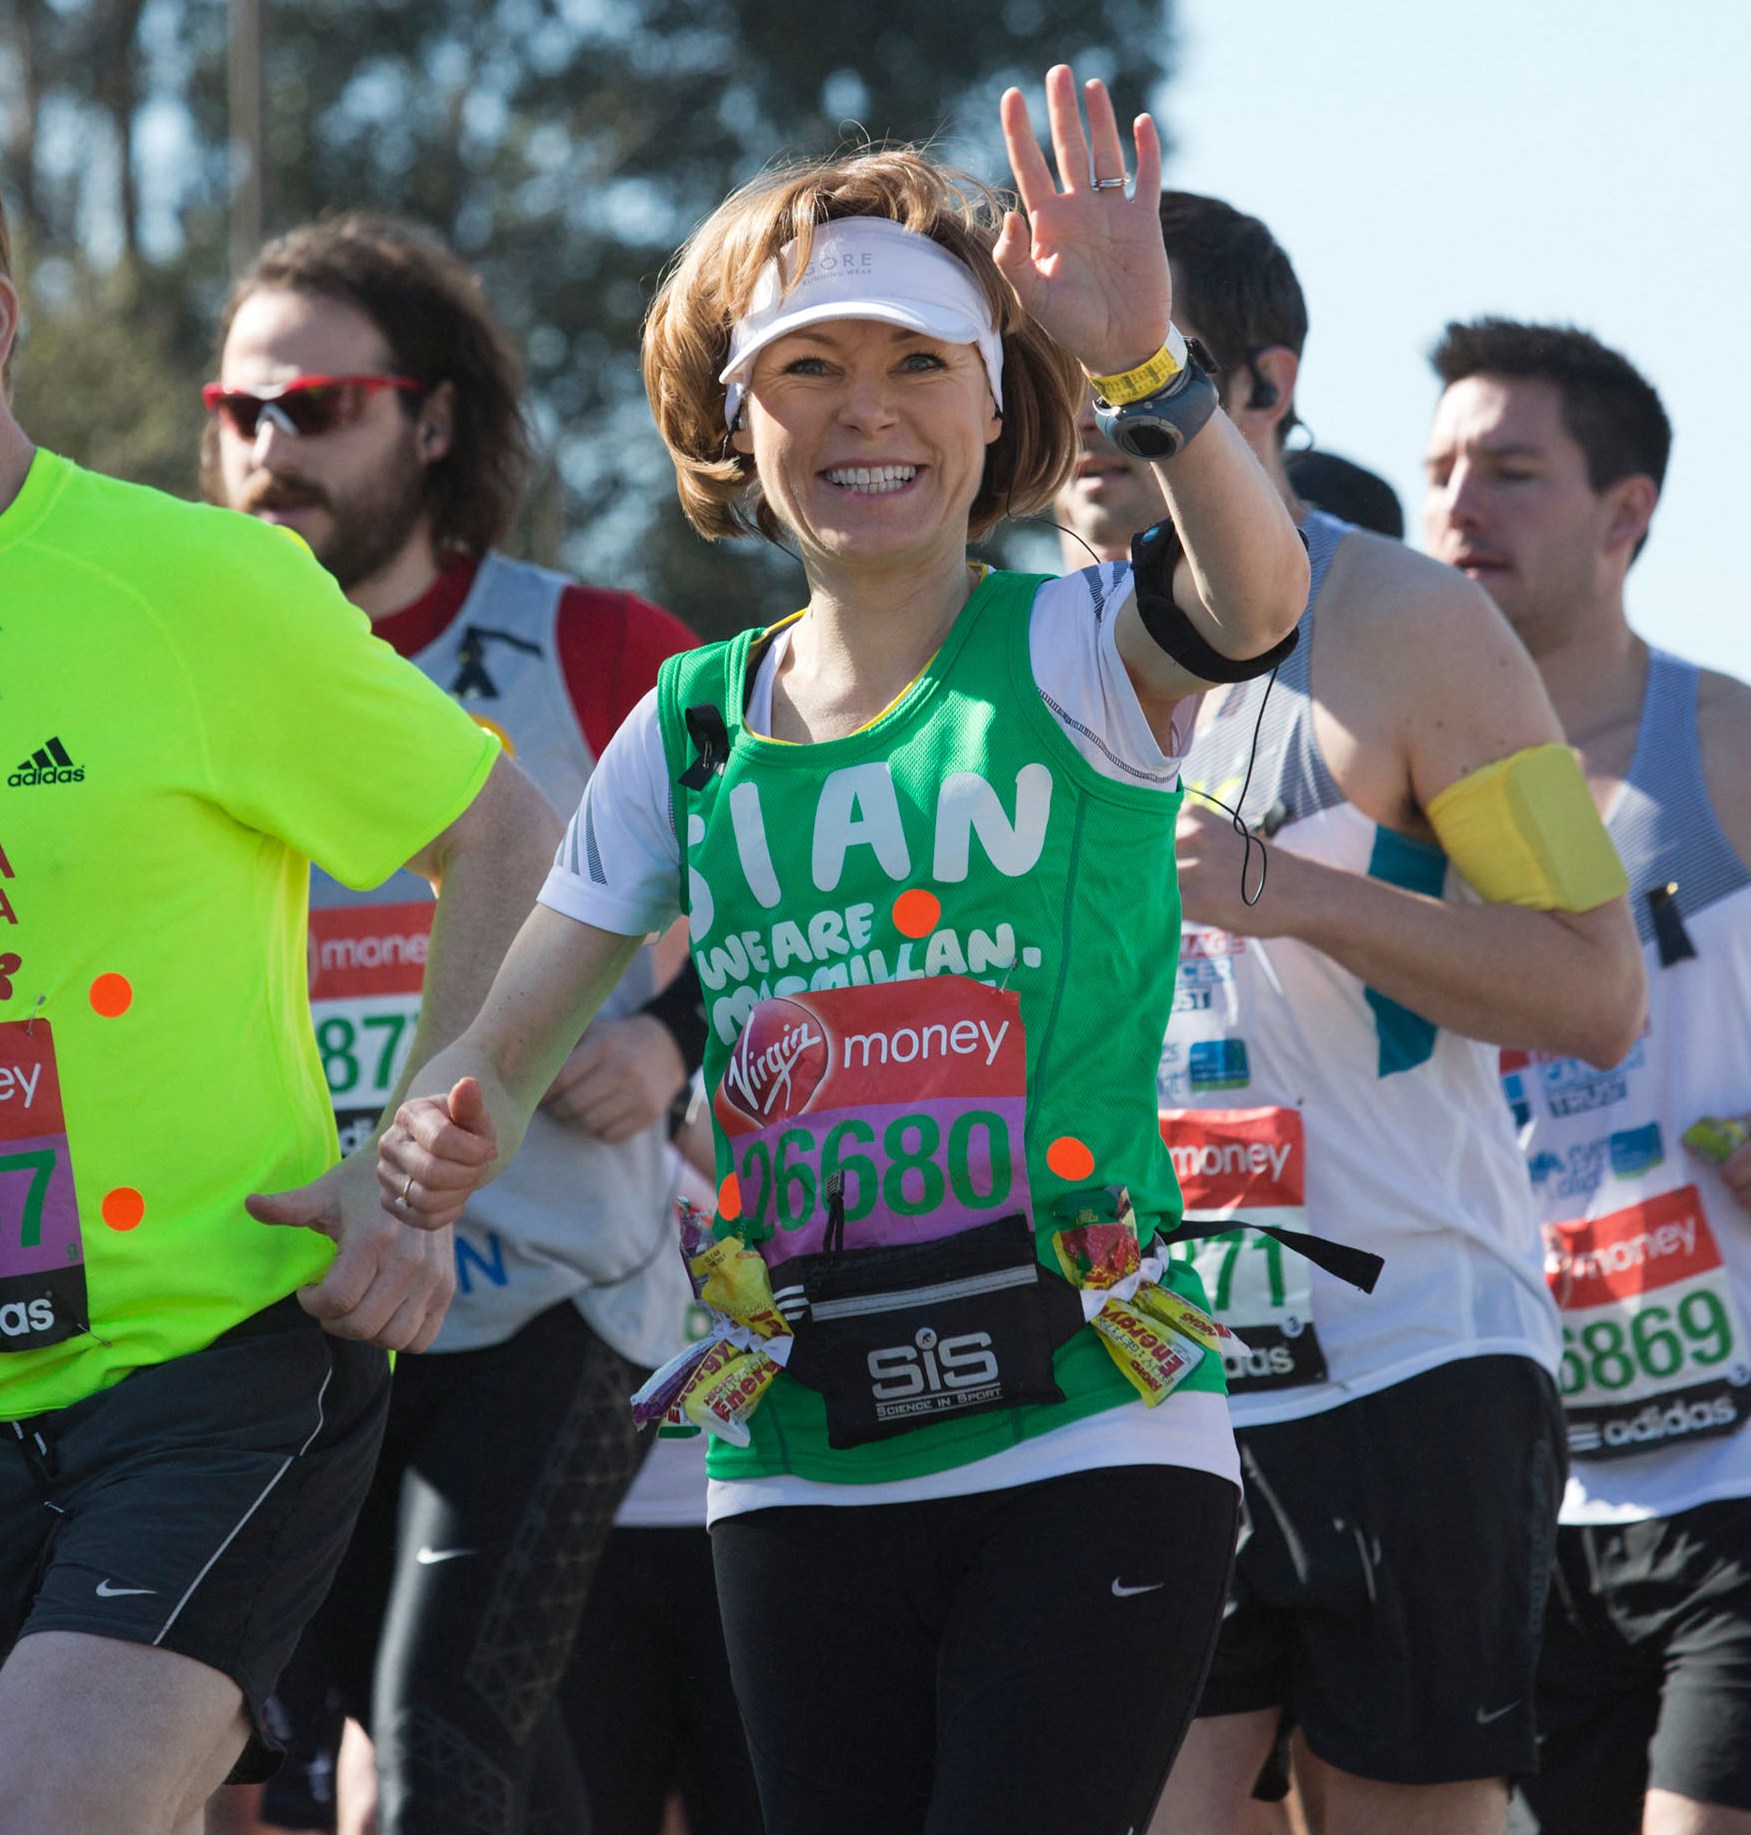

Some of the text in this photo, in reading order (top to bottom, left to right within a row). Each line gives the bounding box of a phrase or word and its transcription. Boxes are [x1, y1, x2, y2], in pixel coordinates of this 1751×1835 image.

[7, 766, 85, 787] adidas
[316, 1012, 420, 1095] 87
[728, 1011, 1010, 1116] Virgin money
[741, 1109, 1013, 1244] 26680
[1168, 1142, 1292, 1184] money
[1169, 1223, 1284, 1311] 71
[1603, 1399, 1738, 1446] adidas
